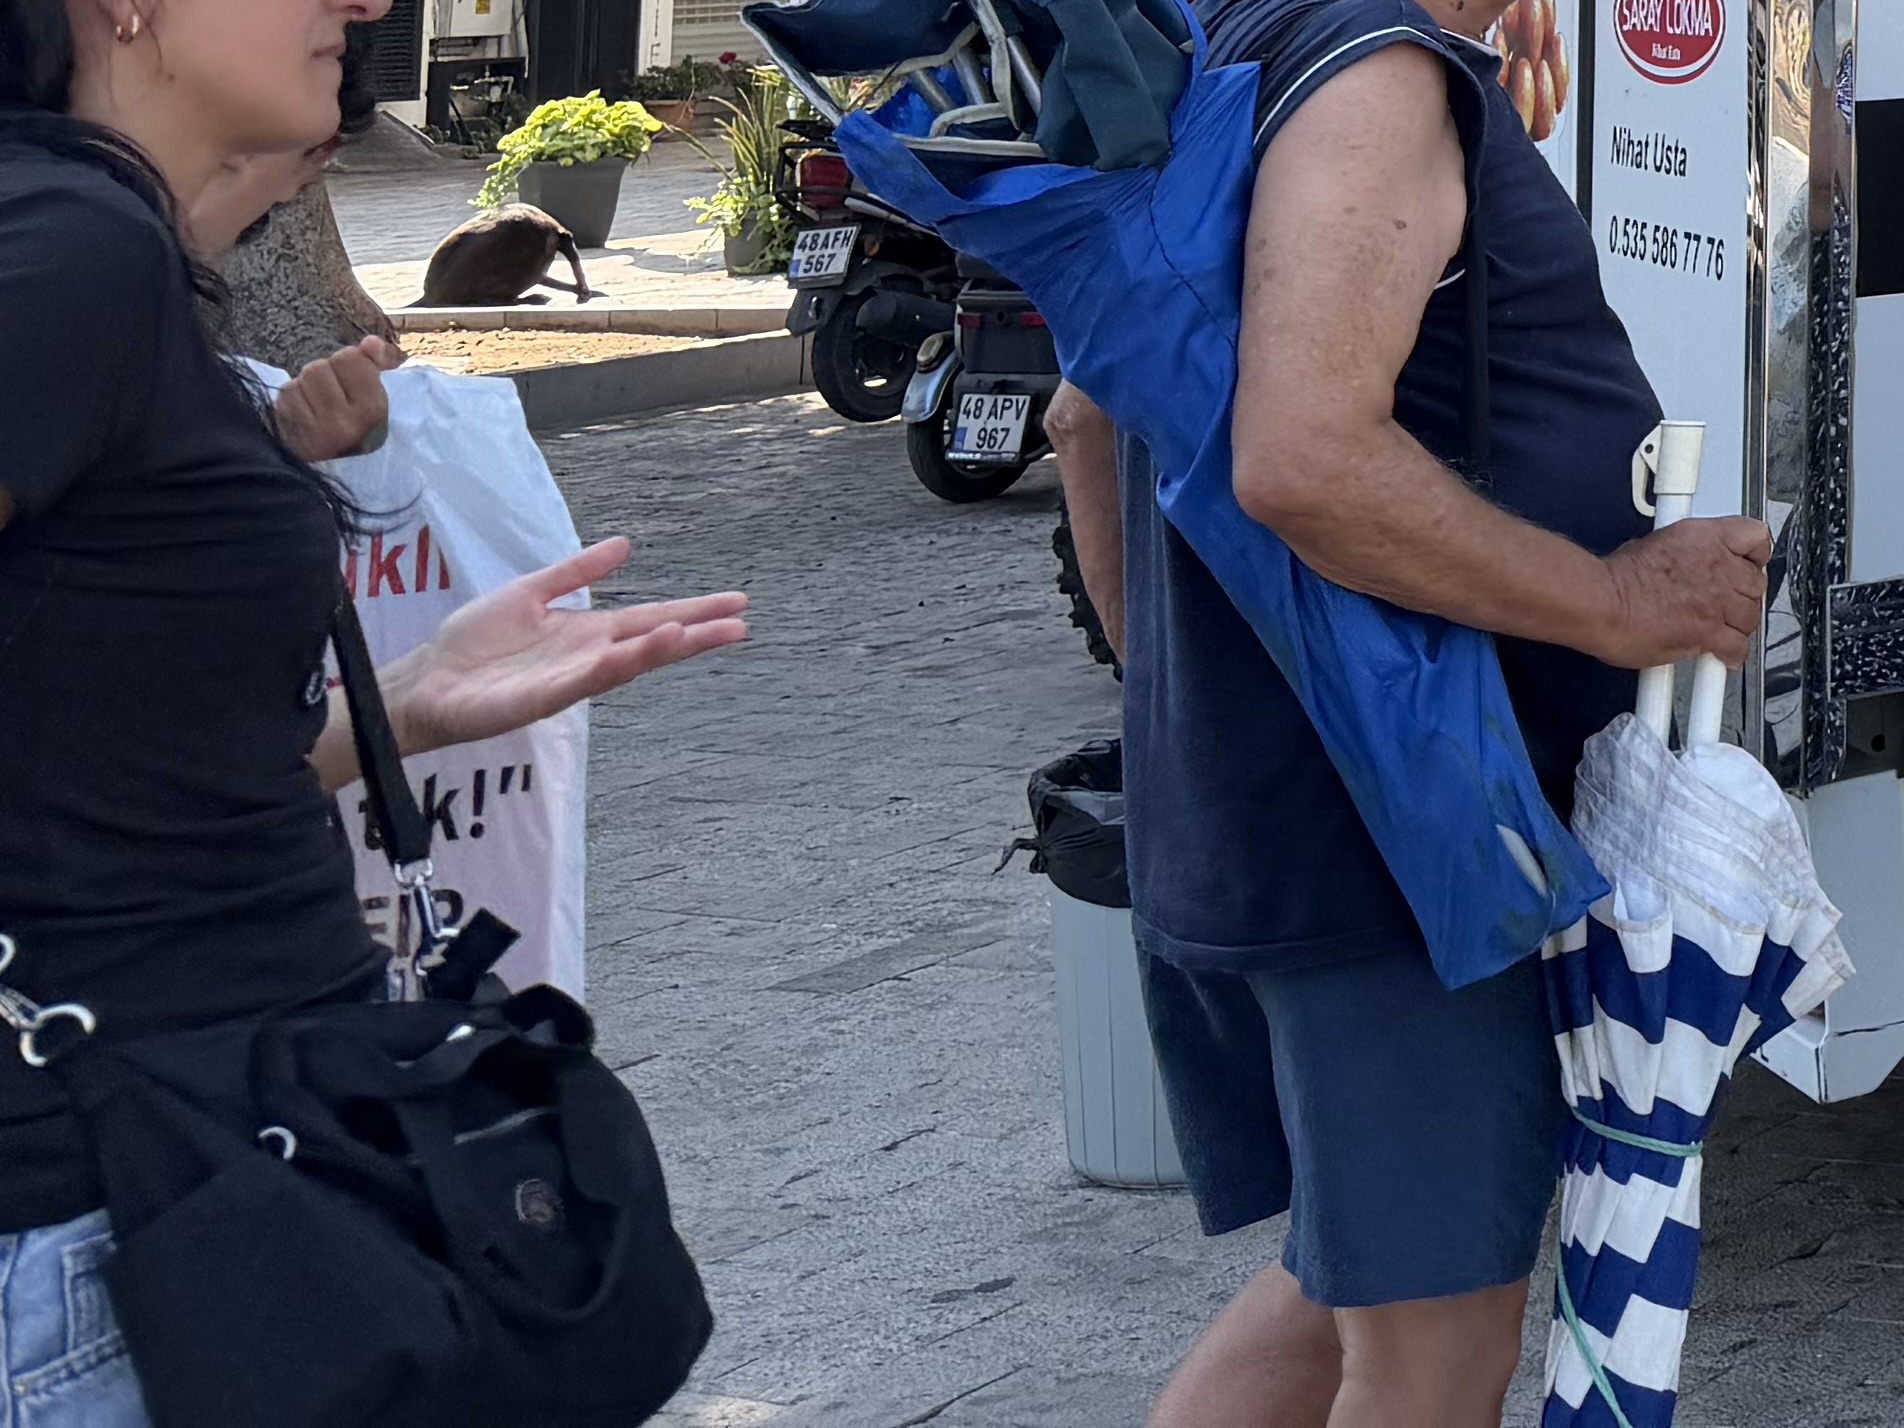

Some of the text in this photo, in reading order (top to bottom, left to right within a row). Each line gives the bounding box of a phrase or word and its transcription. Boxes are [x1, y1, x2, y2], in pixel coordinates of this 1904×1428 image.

[1611, 125, 1688, 178] Nihat Usta
[1609, 215, 1725, 281] 0.535 586 77 76
[802, 252, 834, 271] 567
[961, 396, 1029, 422] 48 APV
[975, 427, 1011, 450] 967
